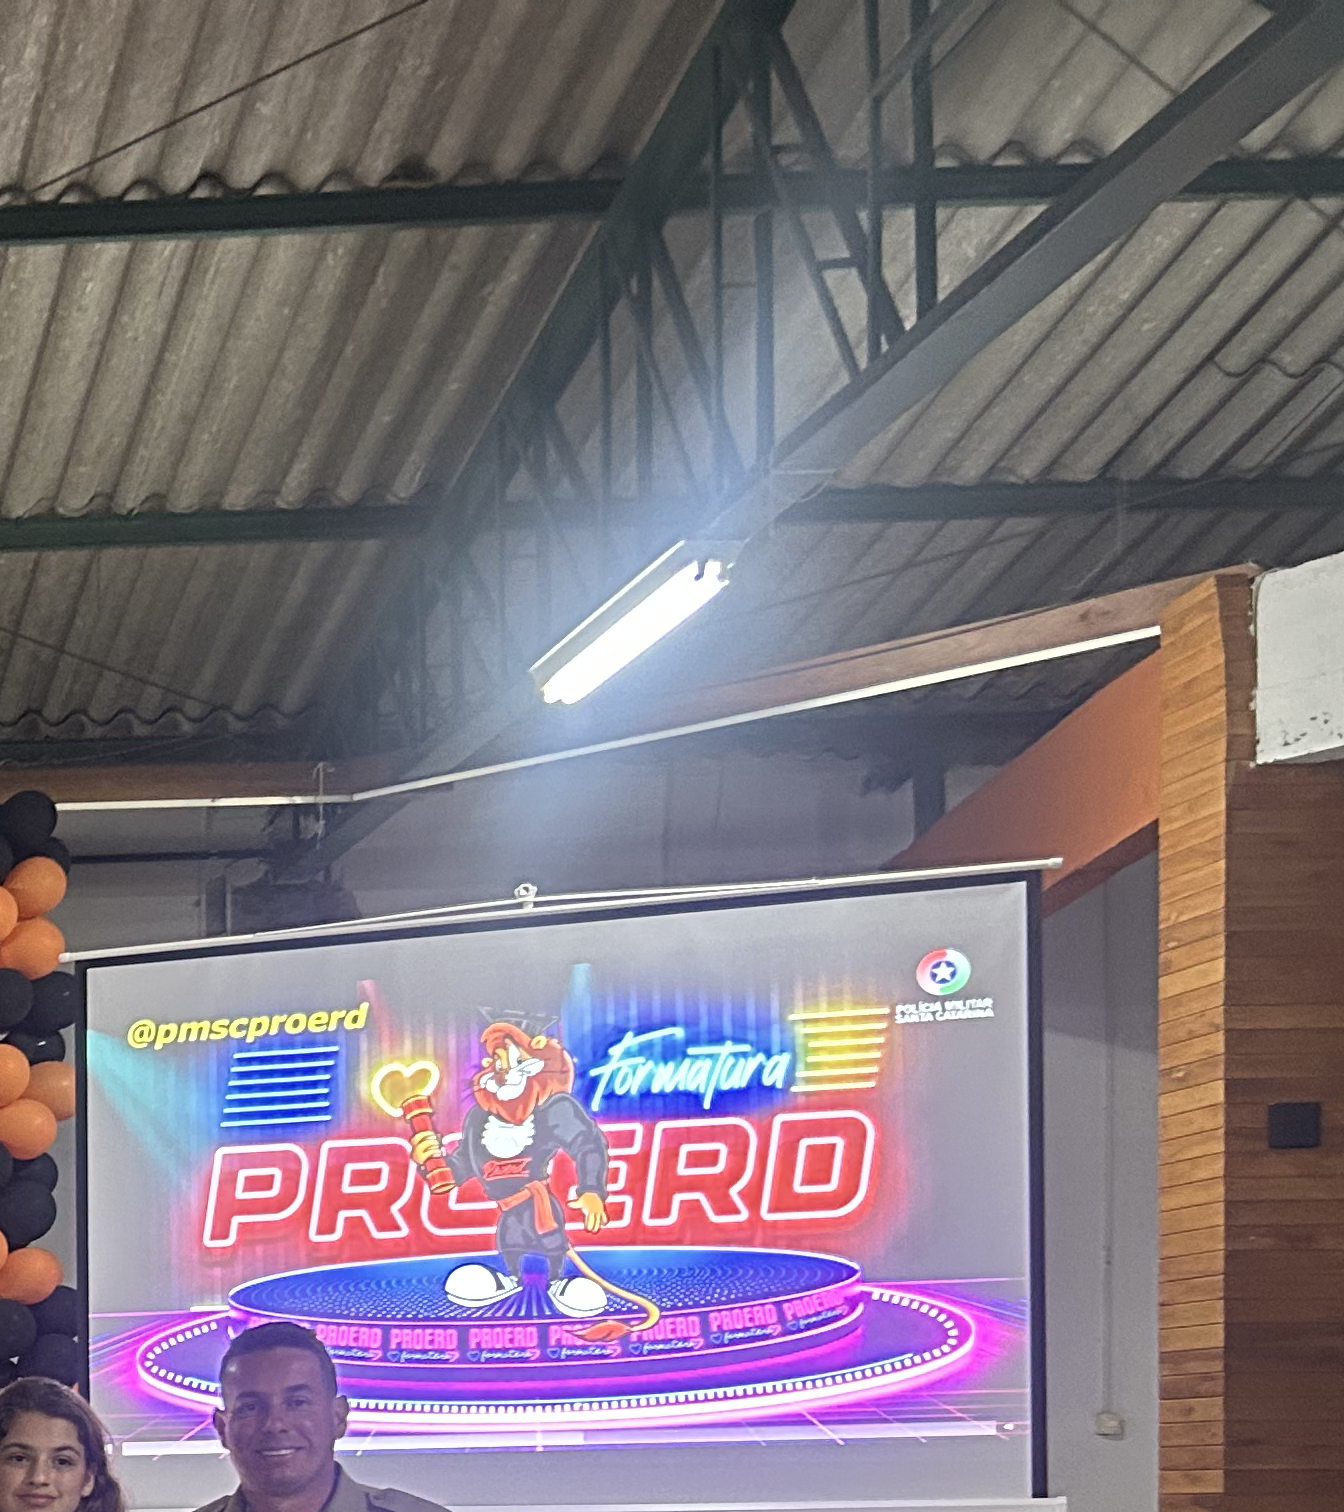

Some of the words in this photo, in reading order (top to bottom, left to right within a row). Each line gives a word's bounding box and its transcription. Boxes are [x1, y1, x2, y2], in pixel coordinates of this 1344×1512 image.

[127, 1003, 369, 1049] @pmscproerd
[590, 1026, 791, 1110] Formatura
[709, 1302, 777, 1332] PROERD
[389, 1327, 458, 1349] PROERD
[468, 1326, 538, 1349] PROERD
